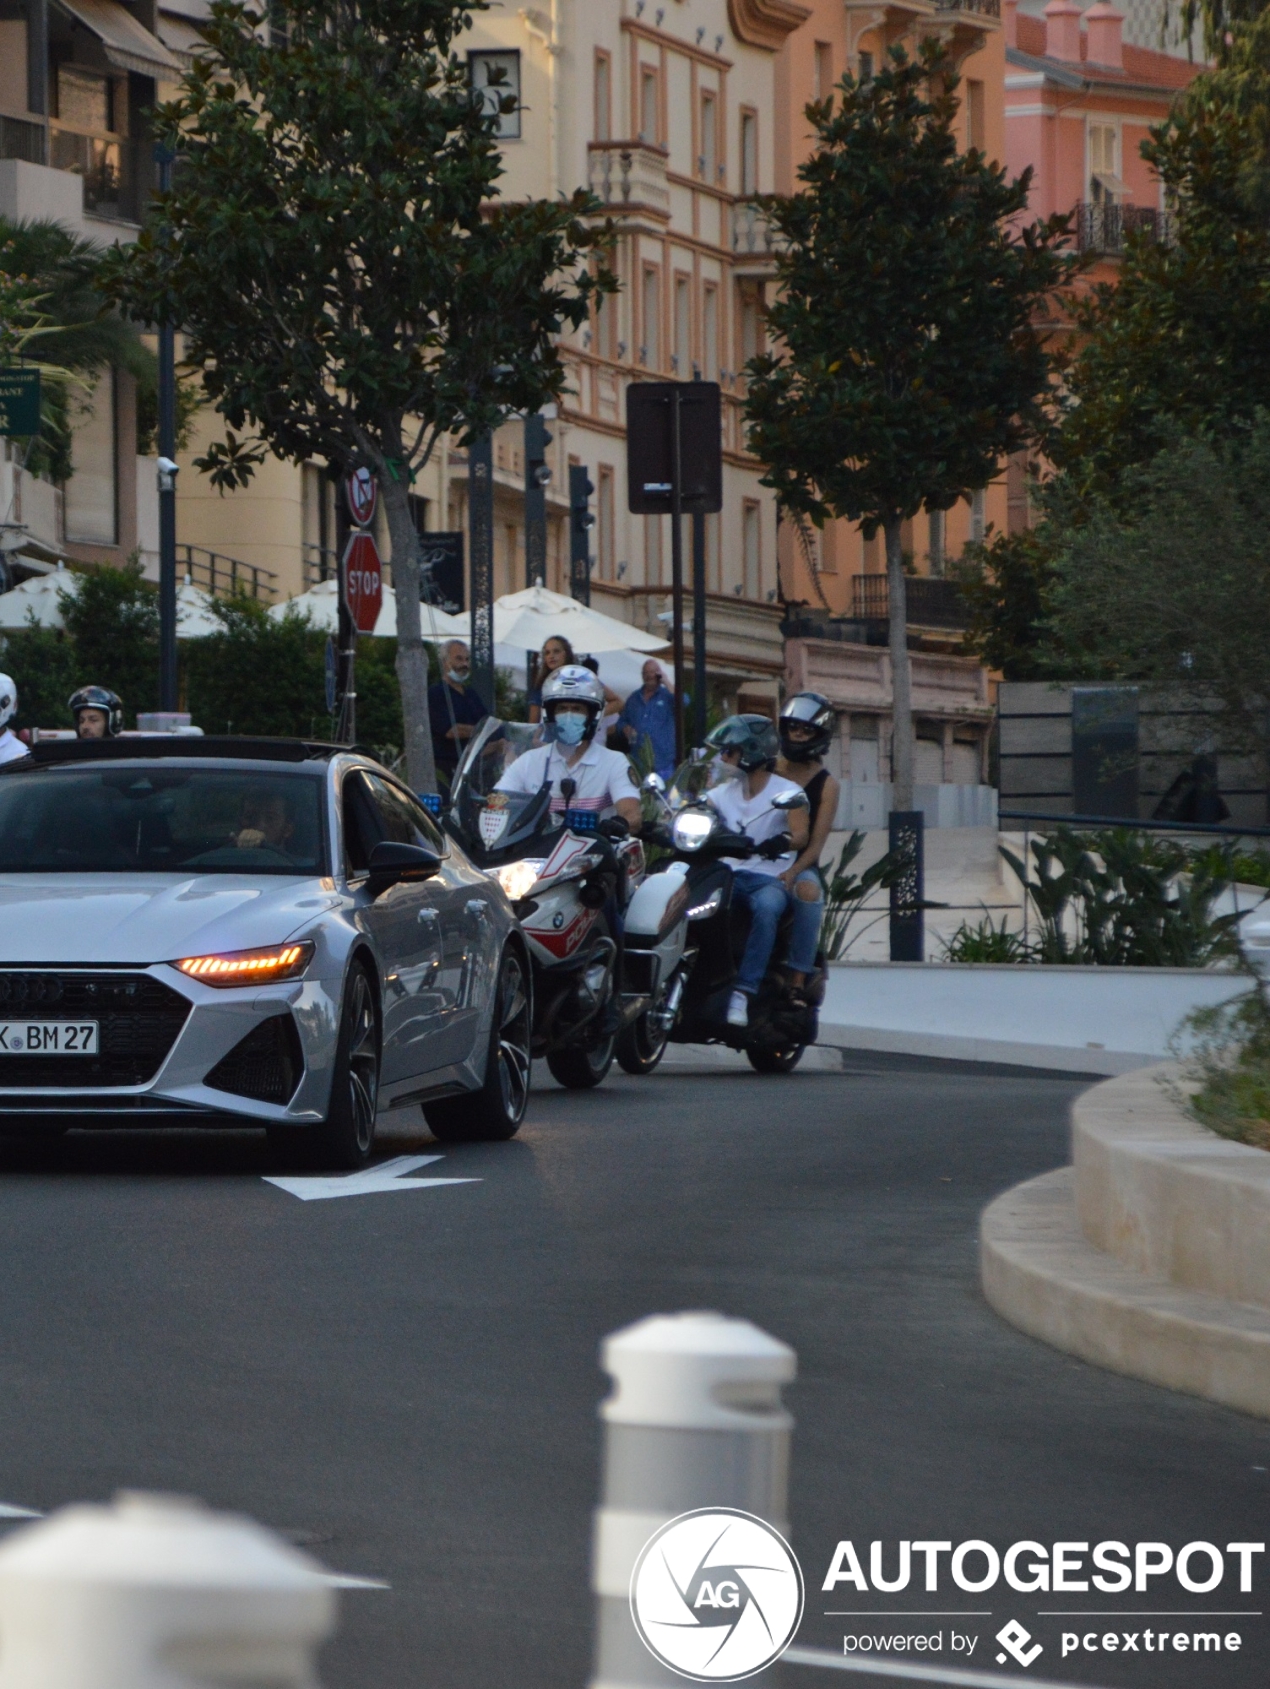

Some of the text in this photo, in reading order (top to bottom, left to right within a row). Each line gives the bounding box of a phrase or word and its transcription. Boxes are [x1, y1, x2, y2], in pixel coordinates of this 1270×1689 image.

[349, 570, 380, 596] STOP
[26, 1026, 59, 1050] BM
[64, 1026, 94, 1050] 27
